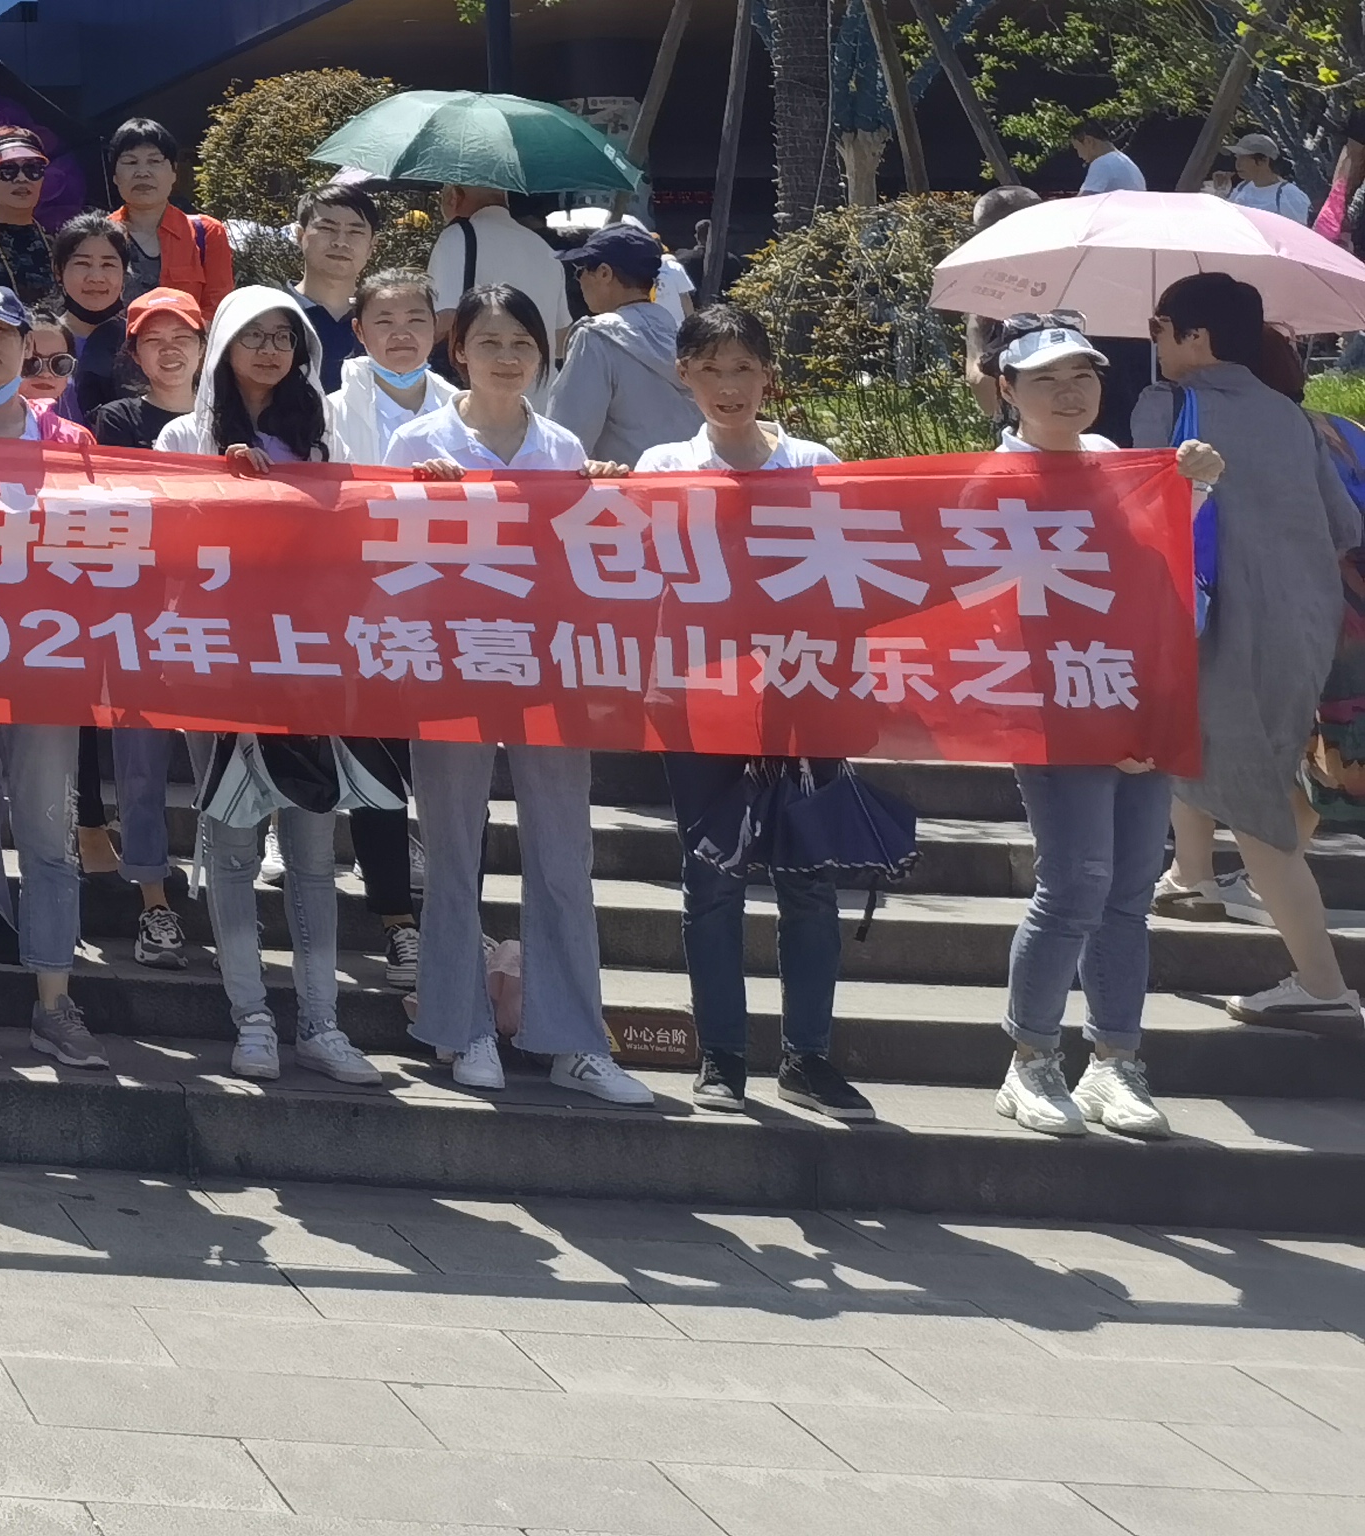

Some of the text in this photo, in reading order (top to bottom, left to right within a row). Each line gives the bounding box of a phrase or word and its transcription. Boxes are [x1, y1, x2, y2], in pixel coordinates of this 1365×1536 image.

[623, 1025, 688, 1045] 小心台阶
[625, 1042, 649, 1051] Watch
[649, 1043, 667, 1052] Your
